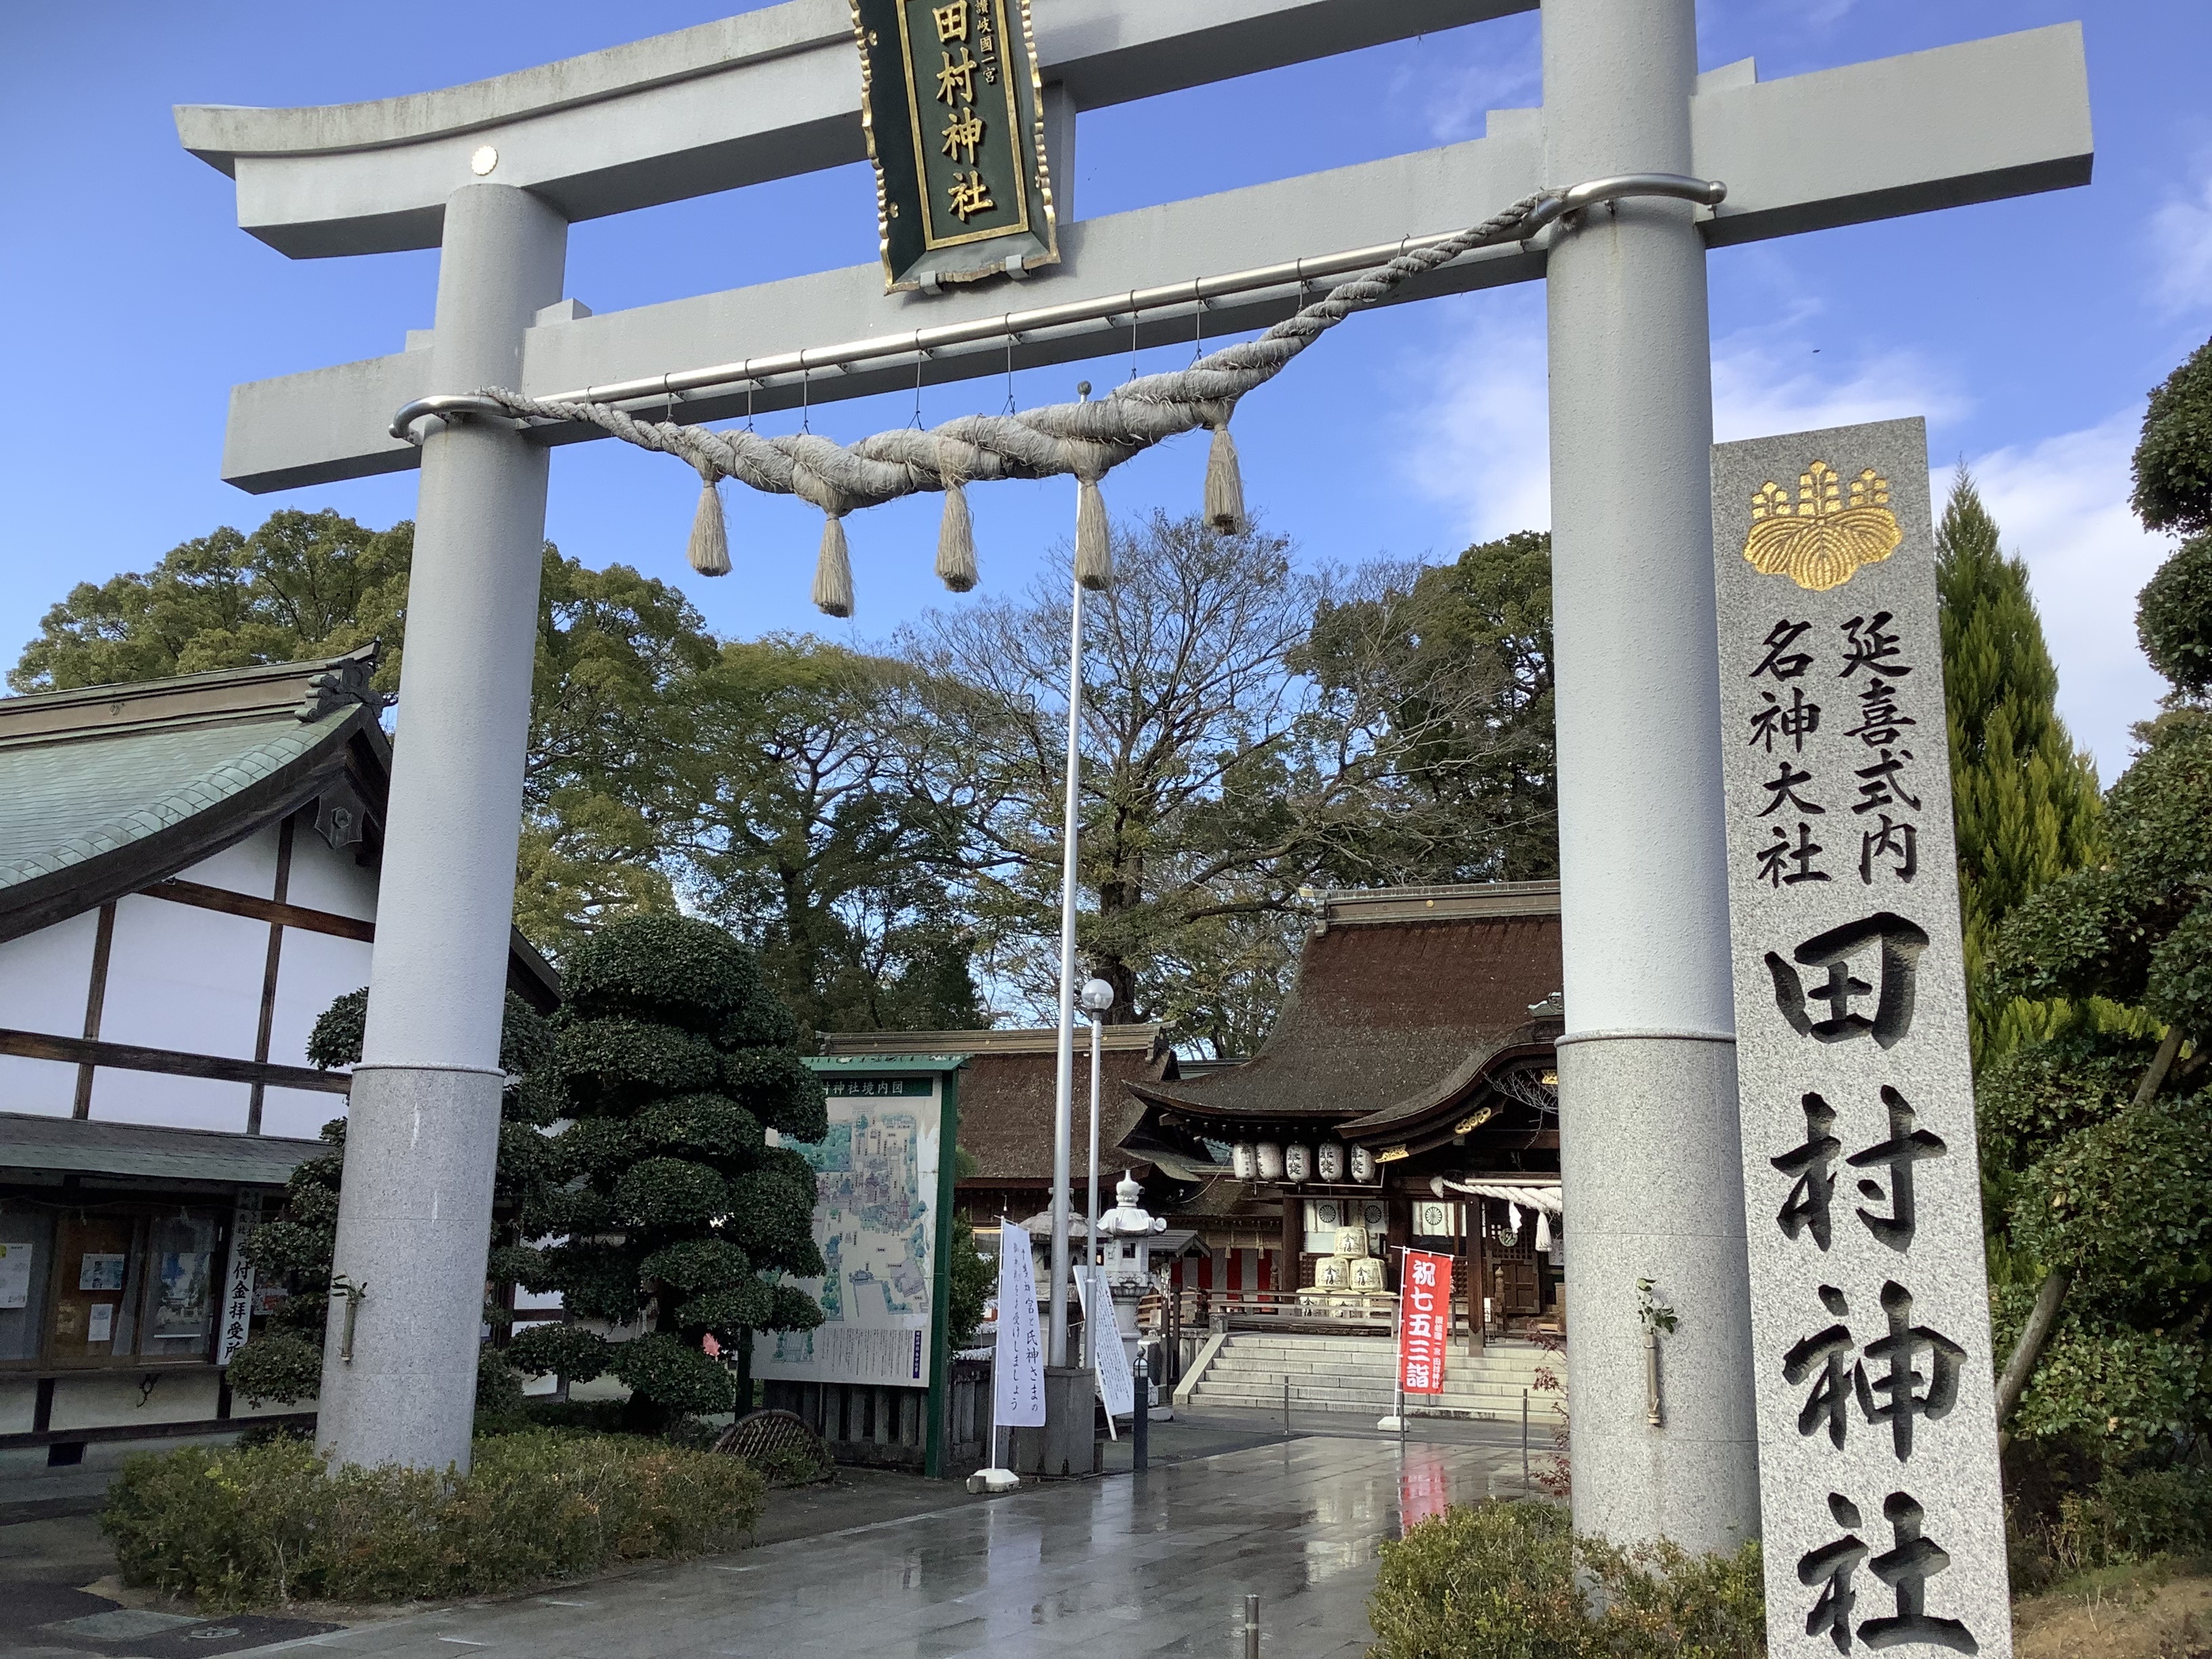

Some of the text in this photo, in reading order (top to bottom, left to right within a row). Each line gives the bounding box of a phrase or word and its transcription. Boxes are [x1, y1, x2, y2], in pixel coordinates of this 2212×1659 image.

[932, 0, 994, 222] 田村神社
[1748, 618, 1832, 888] 名神大社
[1837, 611, 1922, 885] 延喜式内
[1406, 1259, 1436, 1388] 祝七五三詣
[1764, 911, 1980, 1656] 田村神社
